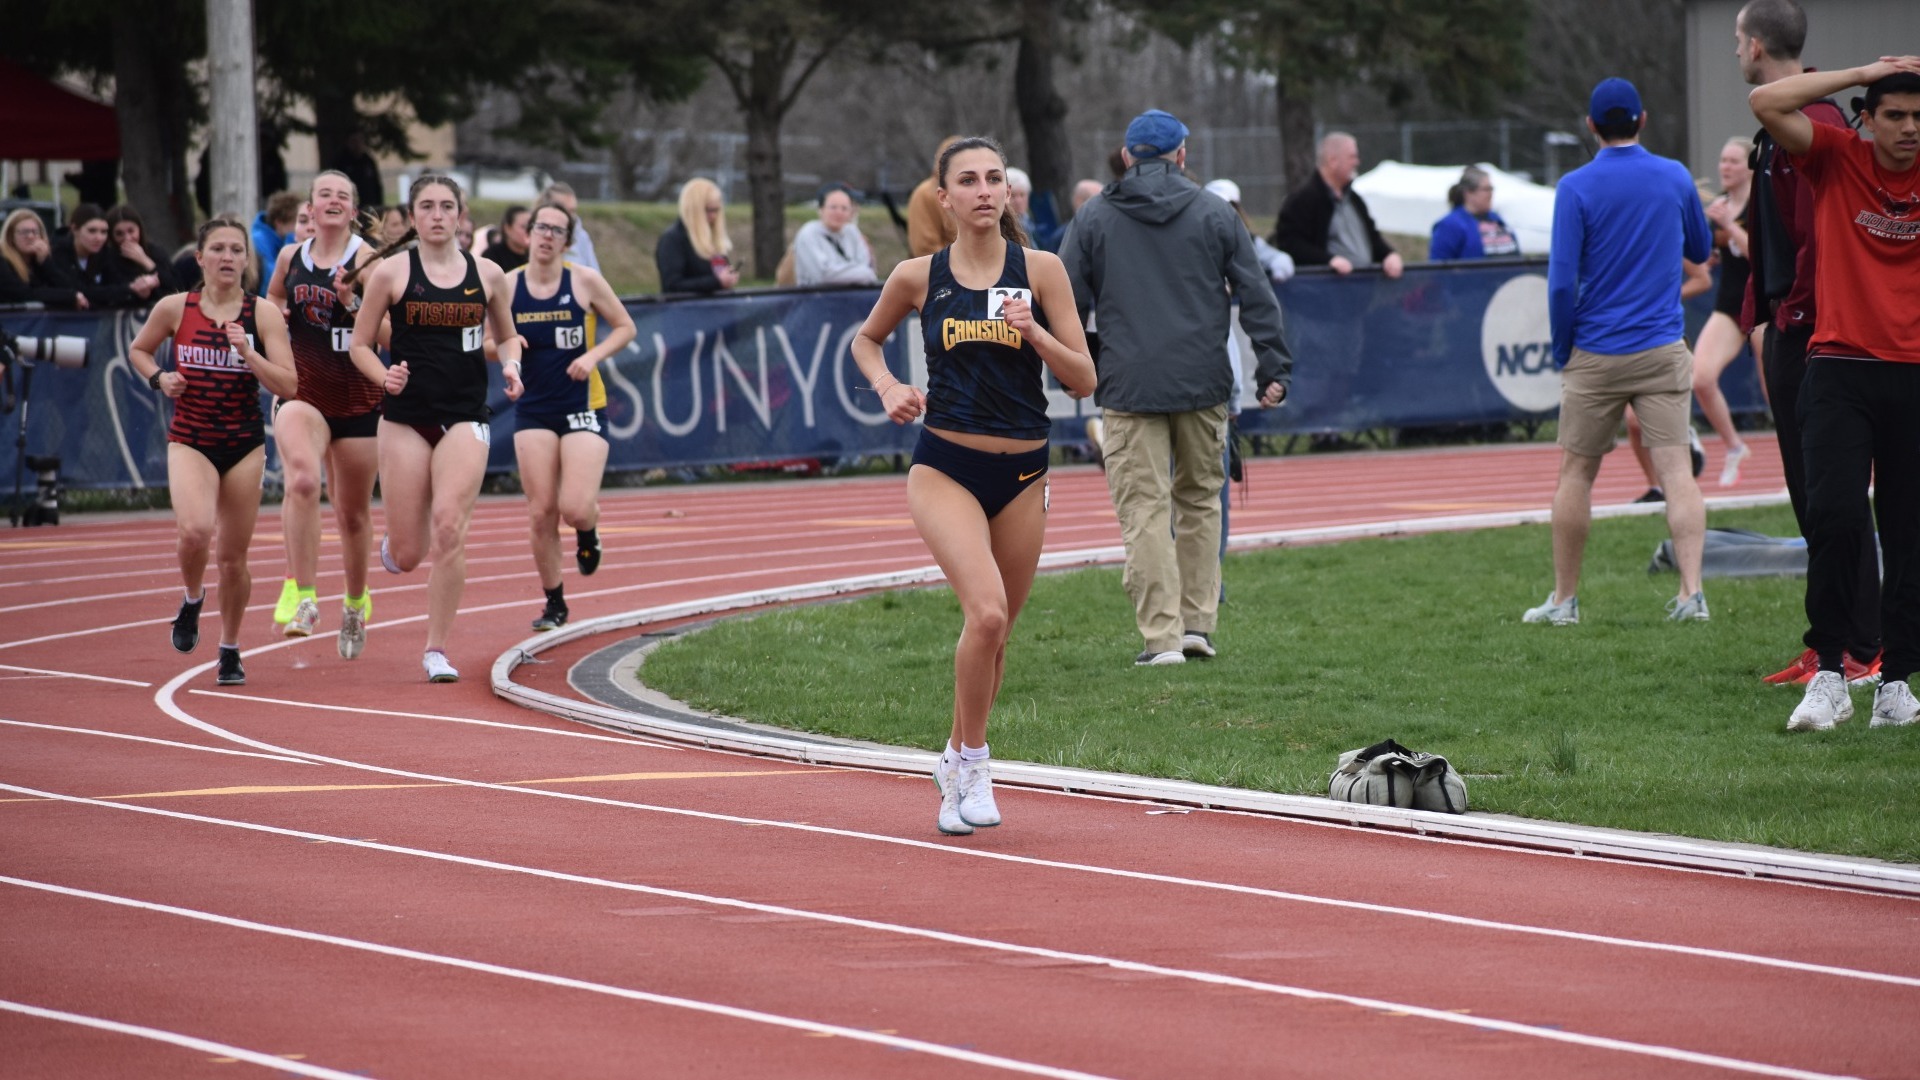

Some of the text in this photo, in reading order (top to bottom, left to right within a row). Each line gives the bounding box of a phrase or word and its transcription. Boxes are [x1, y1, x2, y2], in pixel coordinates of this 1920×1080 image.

[1867, 228, 1891, 239] TRACK
[294, 284, 336, 308] RIT
[516, 310, 572, 324] ROCHESTER
[561, 329, 579, 347] 16
[942, 317, 1022, 352] CANISIUS
[1496, 342, 1564, 377] NCA
